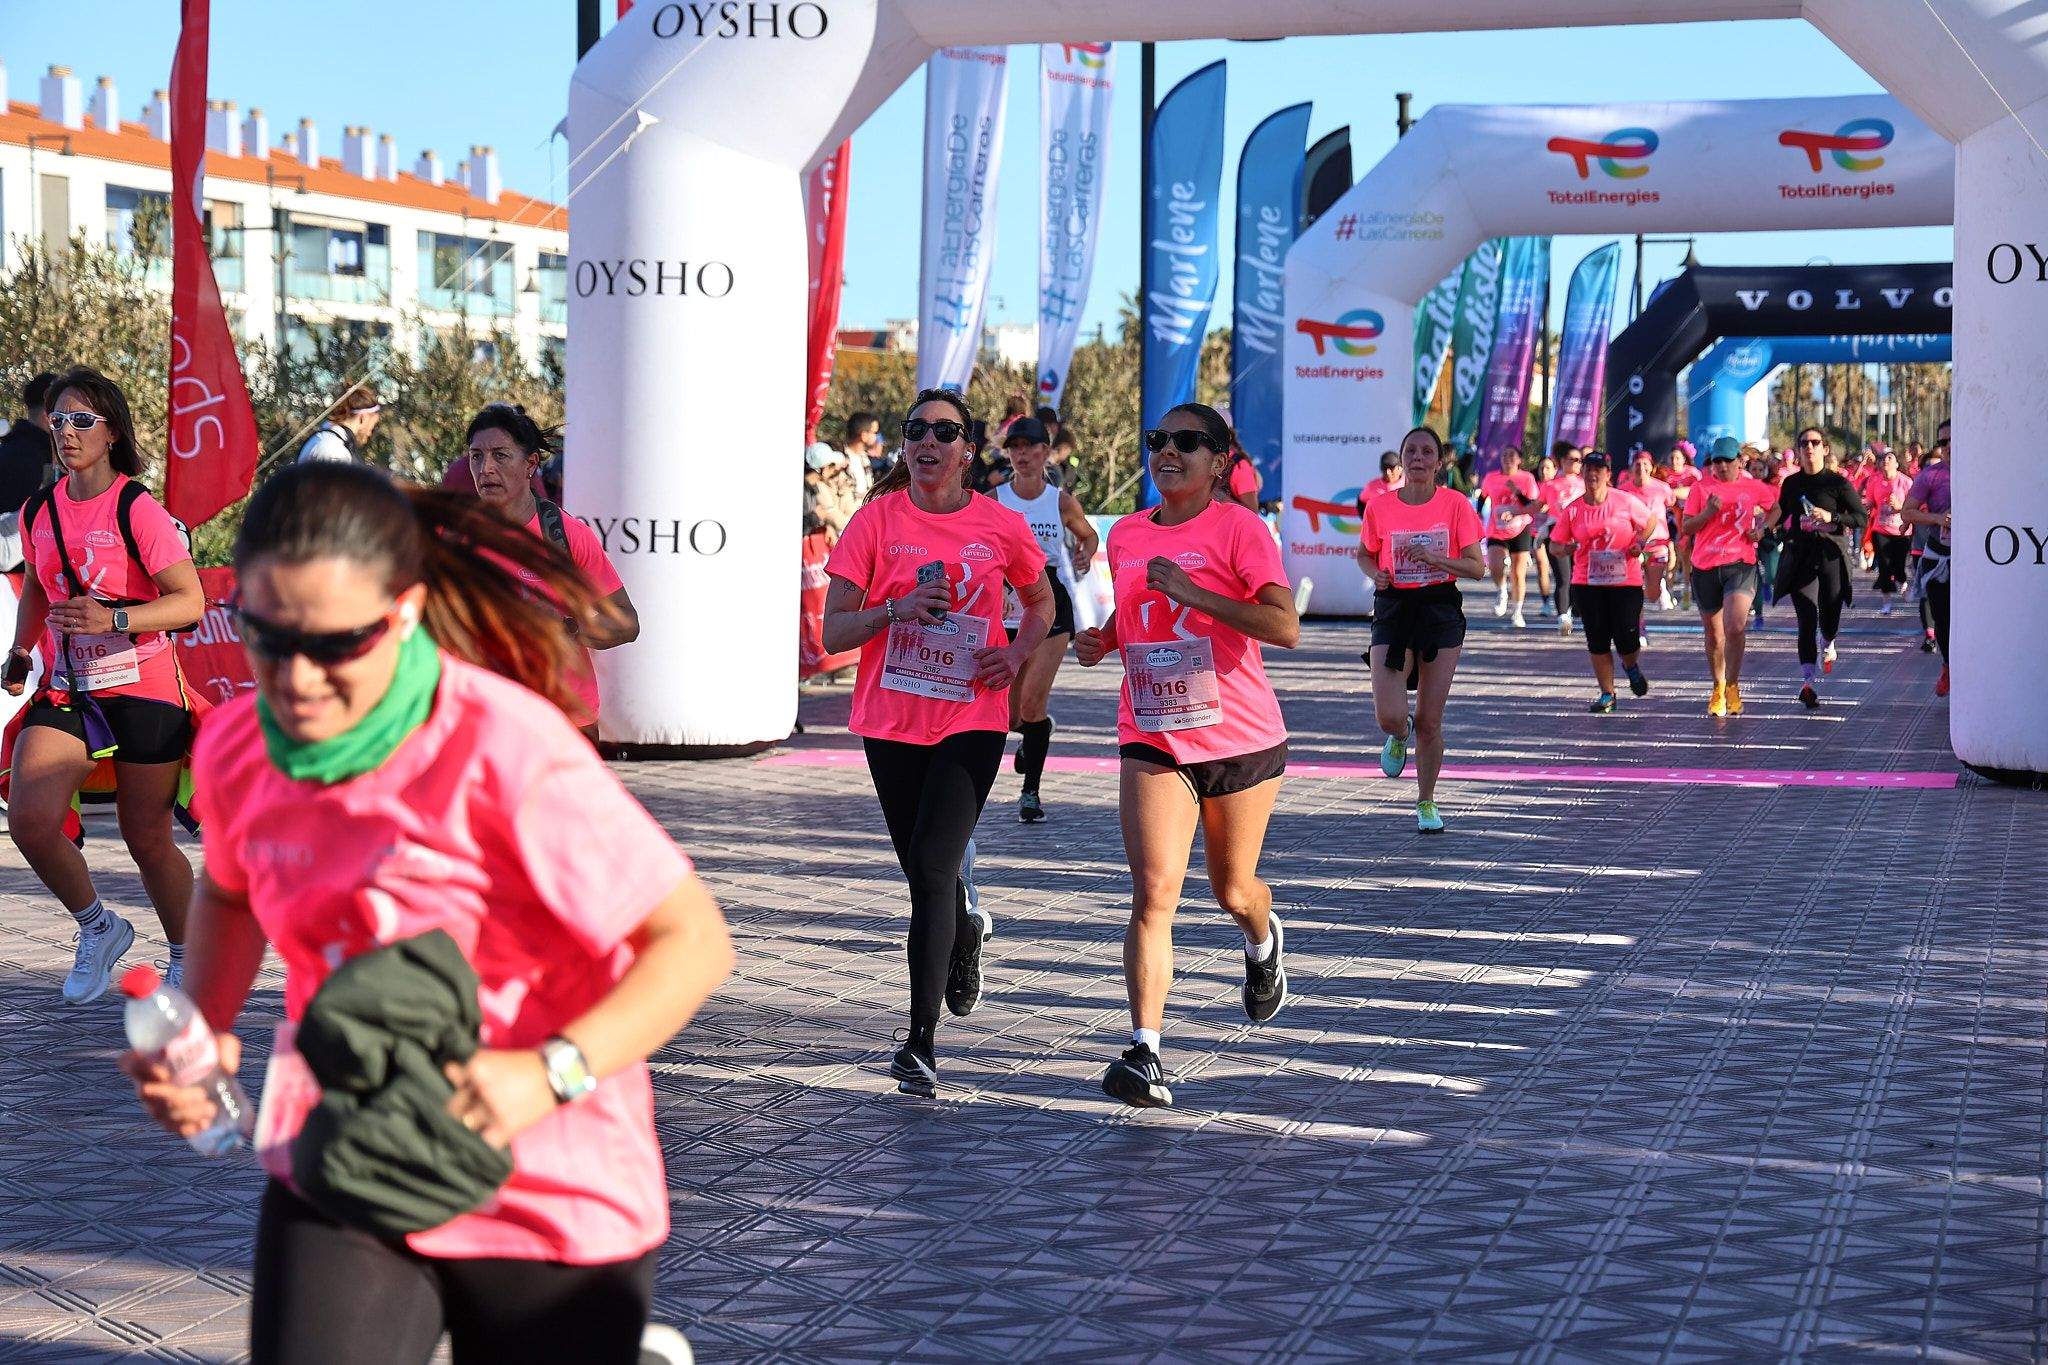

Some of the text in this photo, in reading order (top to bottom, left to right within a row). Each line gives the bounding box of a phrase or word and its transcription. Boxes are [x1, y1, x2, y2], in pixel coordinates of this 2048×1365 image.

[653, 2, 828, 39] OYSHO
[1547, 189, 1660, 205] TotalEnergies
[1778, 181, 1896, 200] TotalEnergies
[1150, 180, 1213, 346] Marlene
[1987, 243, 2048, 284] OY
[576, 259, 734, 298] OYSHO
[1237, 205, 1290, 354] Marlene
[1736, 286, 1954, 311] VOLVO
[1295, 366, 1384, 382] TotalEnergies
[575, 515, 727, 556] YSHO
[889, 544, 928, 556] OYSHO
[1985, 525, 2048, 566] OY
[75, 644, 107, 660] 016
[919, 646, 955, 666] 016
[892, 677, 921, 689] OYSHO
[1152, 680, 1187, 697] 016
[1160, 699, 1177, 707] 9383
[1181, 714, 1211, 724] Santander
